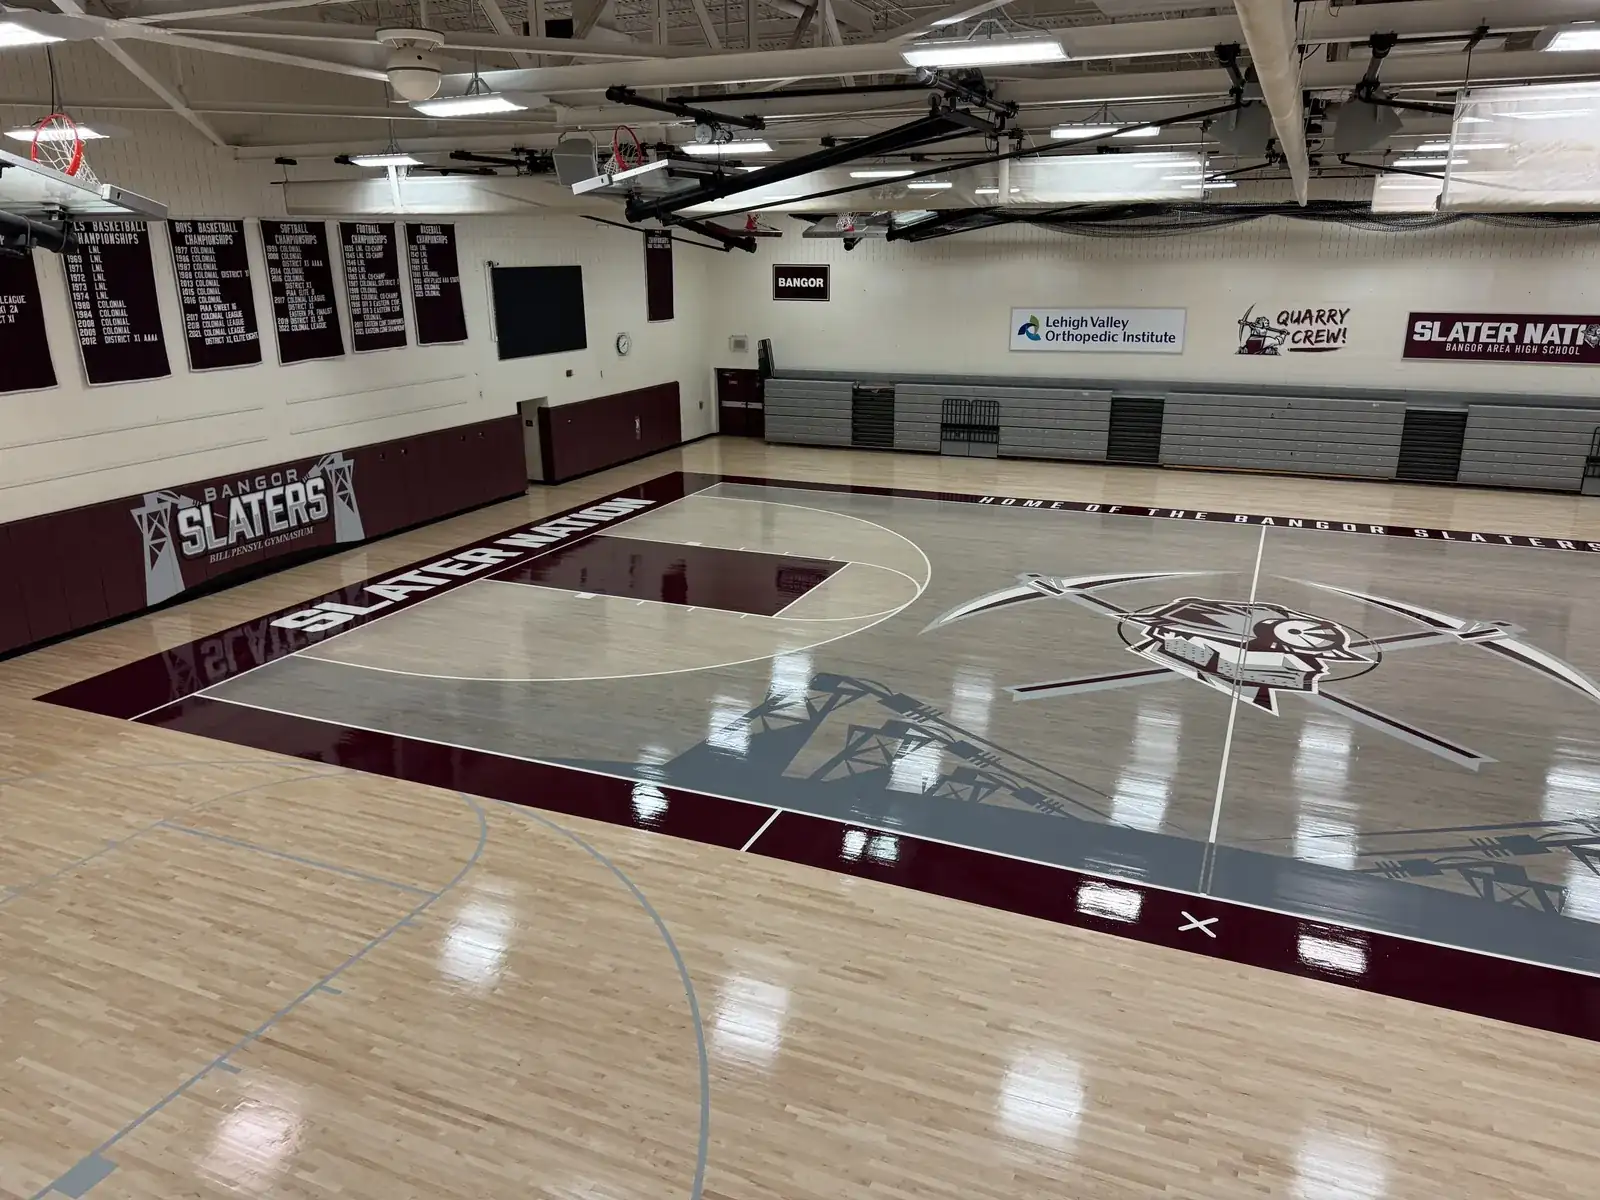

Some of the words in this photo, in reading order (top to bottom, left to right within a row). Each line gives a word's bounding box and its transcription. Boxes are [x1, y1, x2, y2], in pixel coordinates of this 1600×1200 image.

[92, 222, 146, 232] BASKETBALL
[174, 222, 192, 232] BOYS
[198, 222, 238, 233] BASKETBALL
[280, 224, 308, 234] SOFTBALL
[356, 224, 380, 234] FOOTBALL
[420, 225, 442, 234] BASEBALL
[184, 234, 234, 246] CHAMPIONSHIPS
[274, 234, 318, 244] CHAMPIONSHIPS
[351, 234, 388, 244] CHAMPIONSHIPS
[416, 235, 448, 244] CHAMPIONSHIPS
[175, 246, 188, 254] 1977
[190, 246, 216, 254] COLONIAL
[67, 255, 82, 264] 1969
[90, 255, 102, 263] LNL
[192, 254, 216, 262] COLONIAL
[68, 264, 83, 272] 1971
[91, 264, 104, 272] LNL
[70, 274, 86, 282] 1972
[93, 273, 106, 282] LNL
[72, 283, 88, 291] 1973
[94, 282, 108, 290] LNL
[778, 278, 824, 288] BANGOR
[73, 292, 90, 300] 1974
[98, 300, 127, 308] COLONIAL
[10, 305, 18, 314] 2A
[76, 310, 92, 318] 1984
[99, 309, 128, 318] COLONIAL
[226, 310, 243, 319] LEAGUE
[101, 318, 130, 326] COLONIAL
[1277, 308, 1350, 326] QUARRY
[226, 318, 244, 327] LEAGUE
[1046, 316, 1088, 330] Lehigh
[1090, 316, 1130, 330] Valley
[102, 327, 131, 335] COLONIAL
[204, 328, 226, 336] COLONIAL
[228, 326, 246, 335] LEAGUE
[1412, 320, 1518, 343] SLATER
[1524, 324, 1590, 345] NATI
[82, 337, 98, 346] 2012
[104, 335, 130, 344] DISTRICT
[205, 337, 224, 345] DISTRICT
[1046, 330, 1118, 344] Orthopedic
[1122, 332, 1176, 343] Institute
[1292, 328, 1347, 346] CREW!
[1446, 344, 1482, 352] BANGOR
[1487, 344, 1510, 354] AREA
[1515, 345, 1538, 354] HIGH
[1542, 346, 1580, 355] SCHOOL
[204, 468, 298, 501] BANGOR
[176, 476, 328, 556] SLATERS
[978, 496, 1064, 509] HOME
[1085, 504, 1122, 514] OF
[1148, 508, 1208, 520] THE
[1234, 515, 1384, 535] BANGOR
[1414, 528, 1600, 552] SLATERS
[210, 552, 231, 564] BILL
[231, 542, 264, 560] PENSYL
[264, 526, 314, 547] GYMNASIUM
[270, 547, 523, 632] SLATER
[494, 497, 657, 548] NATION
